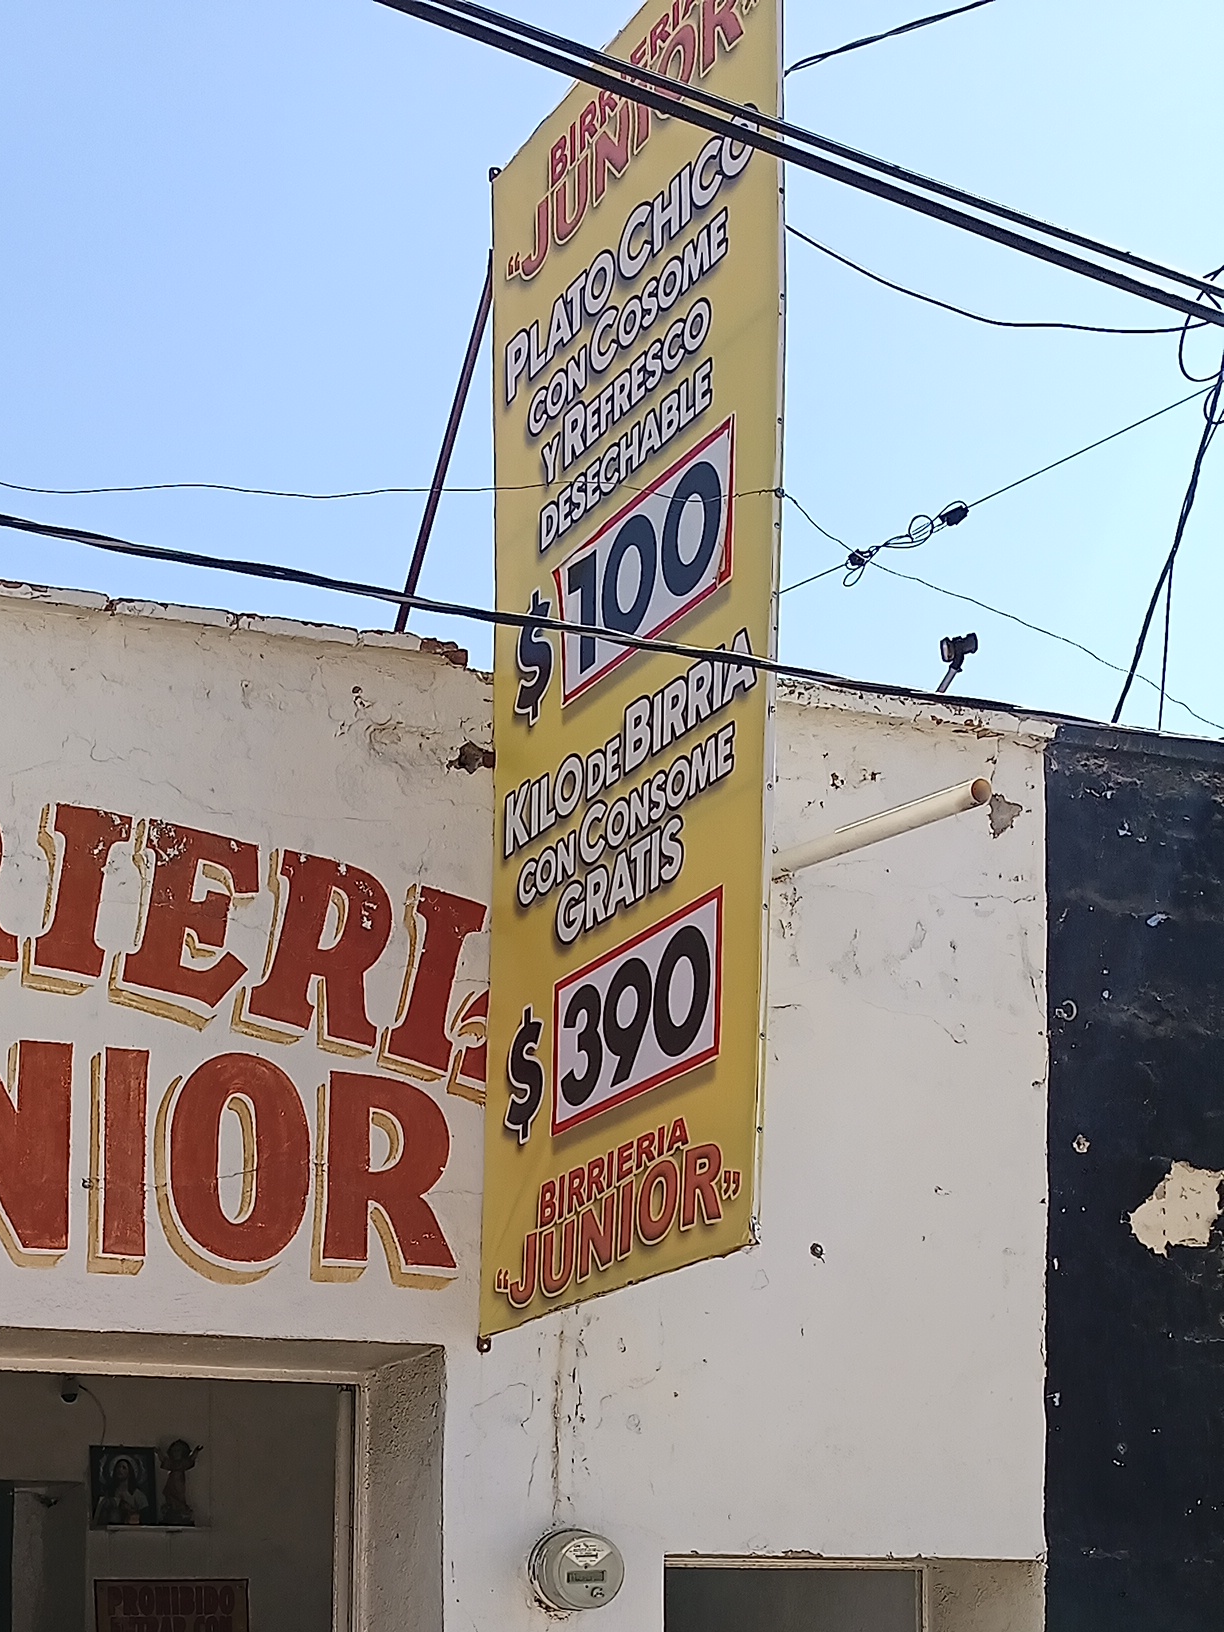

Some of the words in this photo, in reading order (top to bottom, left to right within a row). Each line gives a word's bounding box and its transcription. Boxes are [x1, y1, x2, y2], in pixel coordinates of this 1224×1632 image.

[505, 248, 615, 406] PLATO
[617, 103, 760, 281] CHICO
[527, 347, 587, 438] CON
[590, 207, 729, 374] COSOME
[539, 357, 714, 553] DESECHABLE
[541, 440, 563, 485] Y
[563, 296, 713, 469] REFRESCO
[566, 460, 723, 675] 100
[503, 753, 586, 859] KILO
[586, 737, 623, 799] DE
[624, 627, 759, 774] BIRRIA
[516, 826, 577, 907] CON
[578, 720, 737, 865] CONSOME
[555, 815, 685, 945] GRATIS
[560, 925, 712, 1106] 390
[537, 1117, 690, 1230] BIRRIERIA
[107, 1585, 235, 1616] PROHIBIDO
